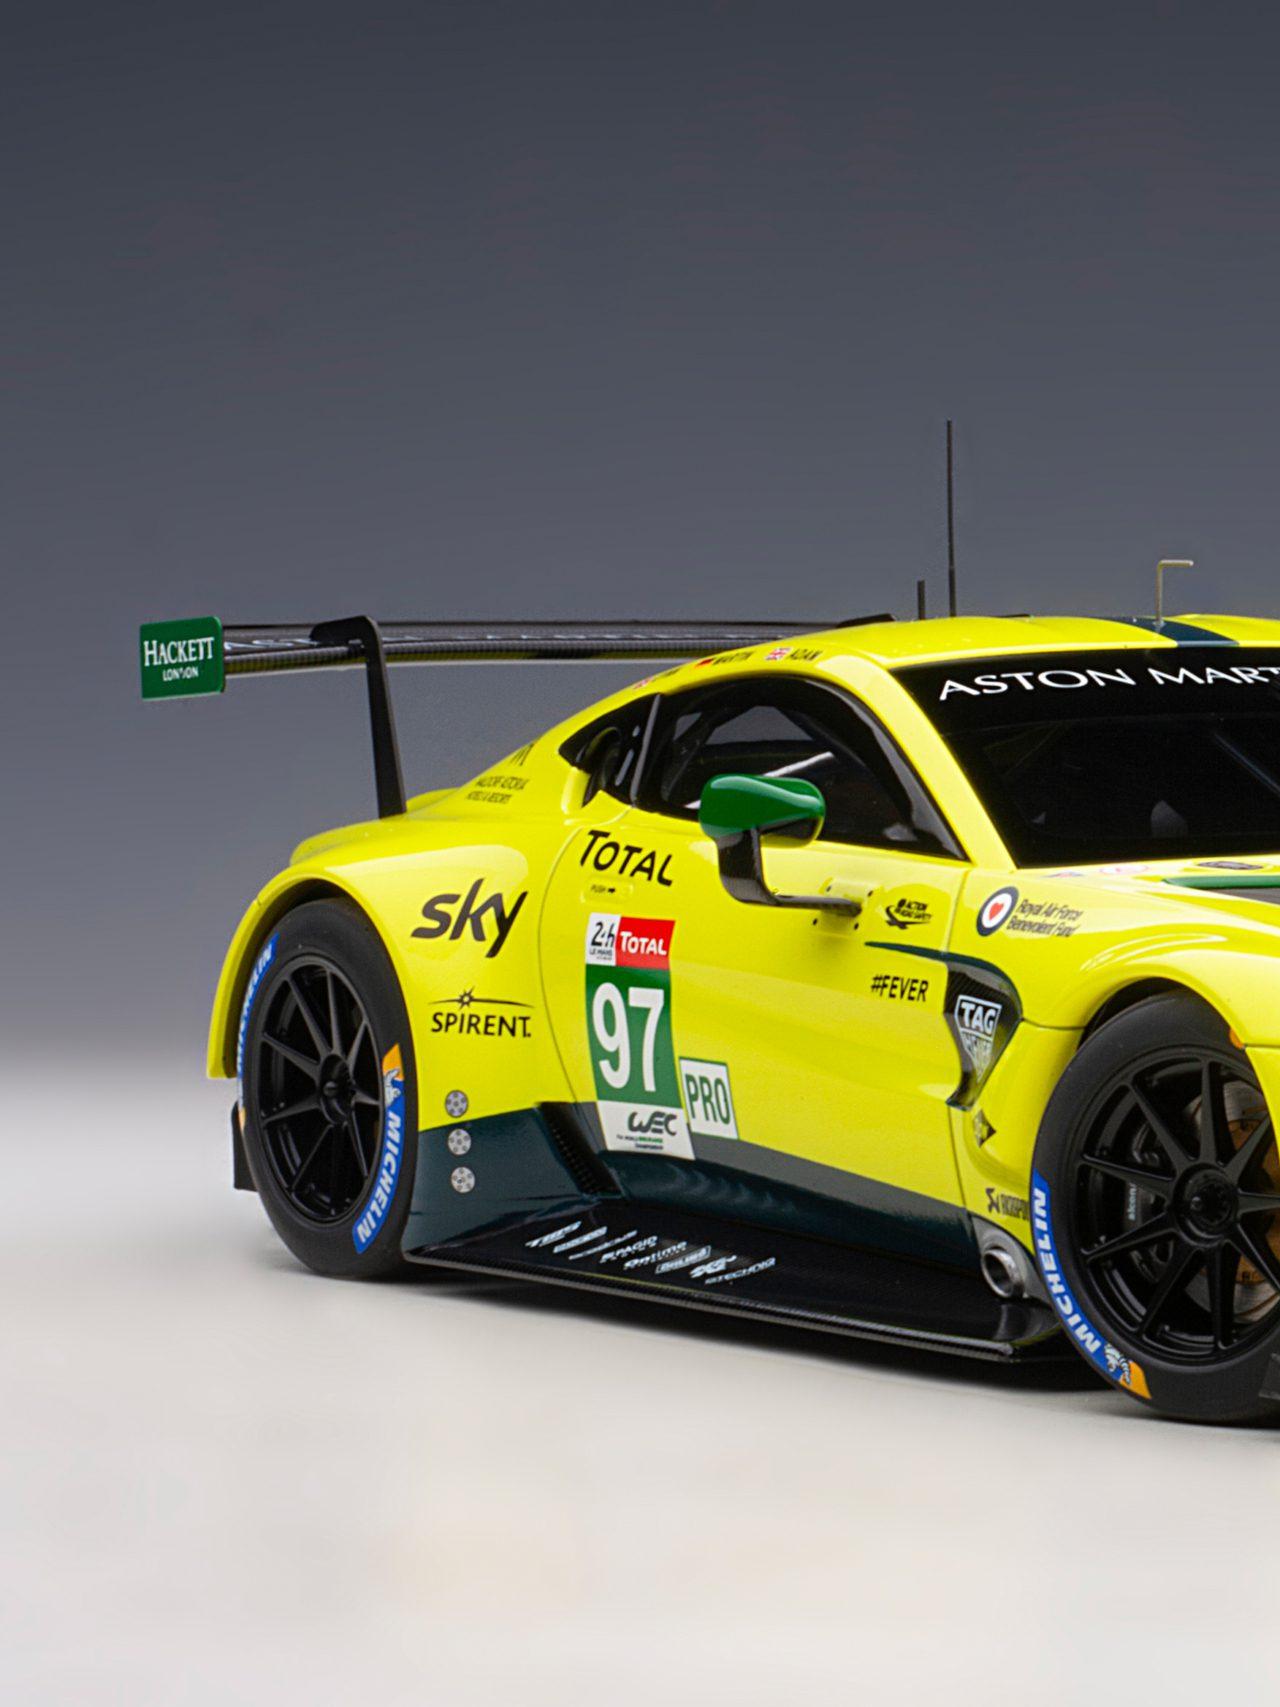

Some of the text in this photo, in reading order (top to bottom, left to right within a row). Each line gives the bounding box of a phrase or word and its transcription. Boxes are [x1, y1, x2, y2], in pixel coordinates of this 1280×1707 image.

[143, 637, 215, 667] HACKETT
[940, 668, 1136, 700] ASTON
[580, 829, 673, 887] TOTAL
[410, 877, 529, 959] sky
[620, 930, 668, 956] TOTAL
[871, 973, 929, 1002] #FEVER
[592, 982, 665, 1092] 97
[961, 1001, 996, 1035] TAG
[684, 1073, 731, 1125] PRO
[628, 1111, 678, 1136] WEC
[357, 1111, 401, 1245] MICHELIN
[1033, 1186, 1101, 1354] MICHELIN
